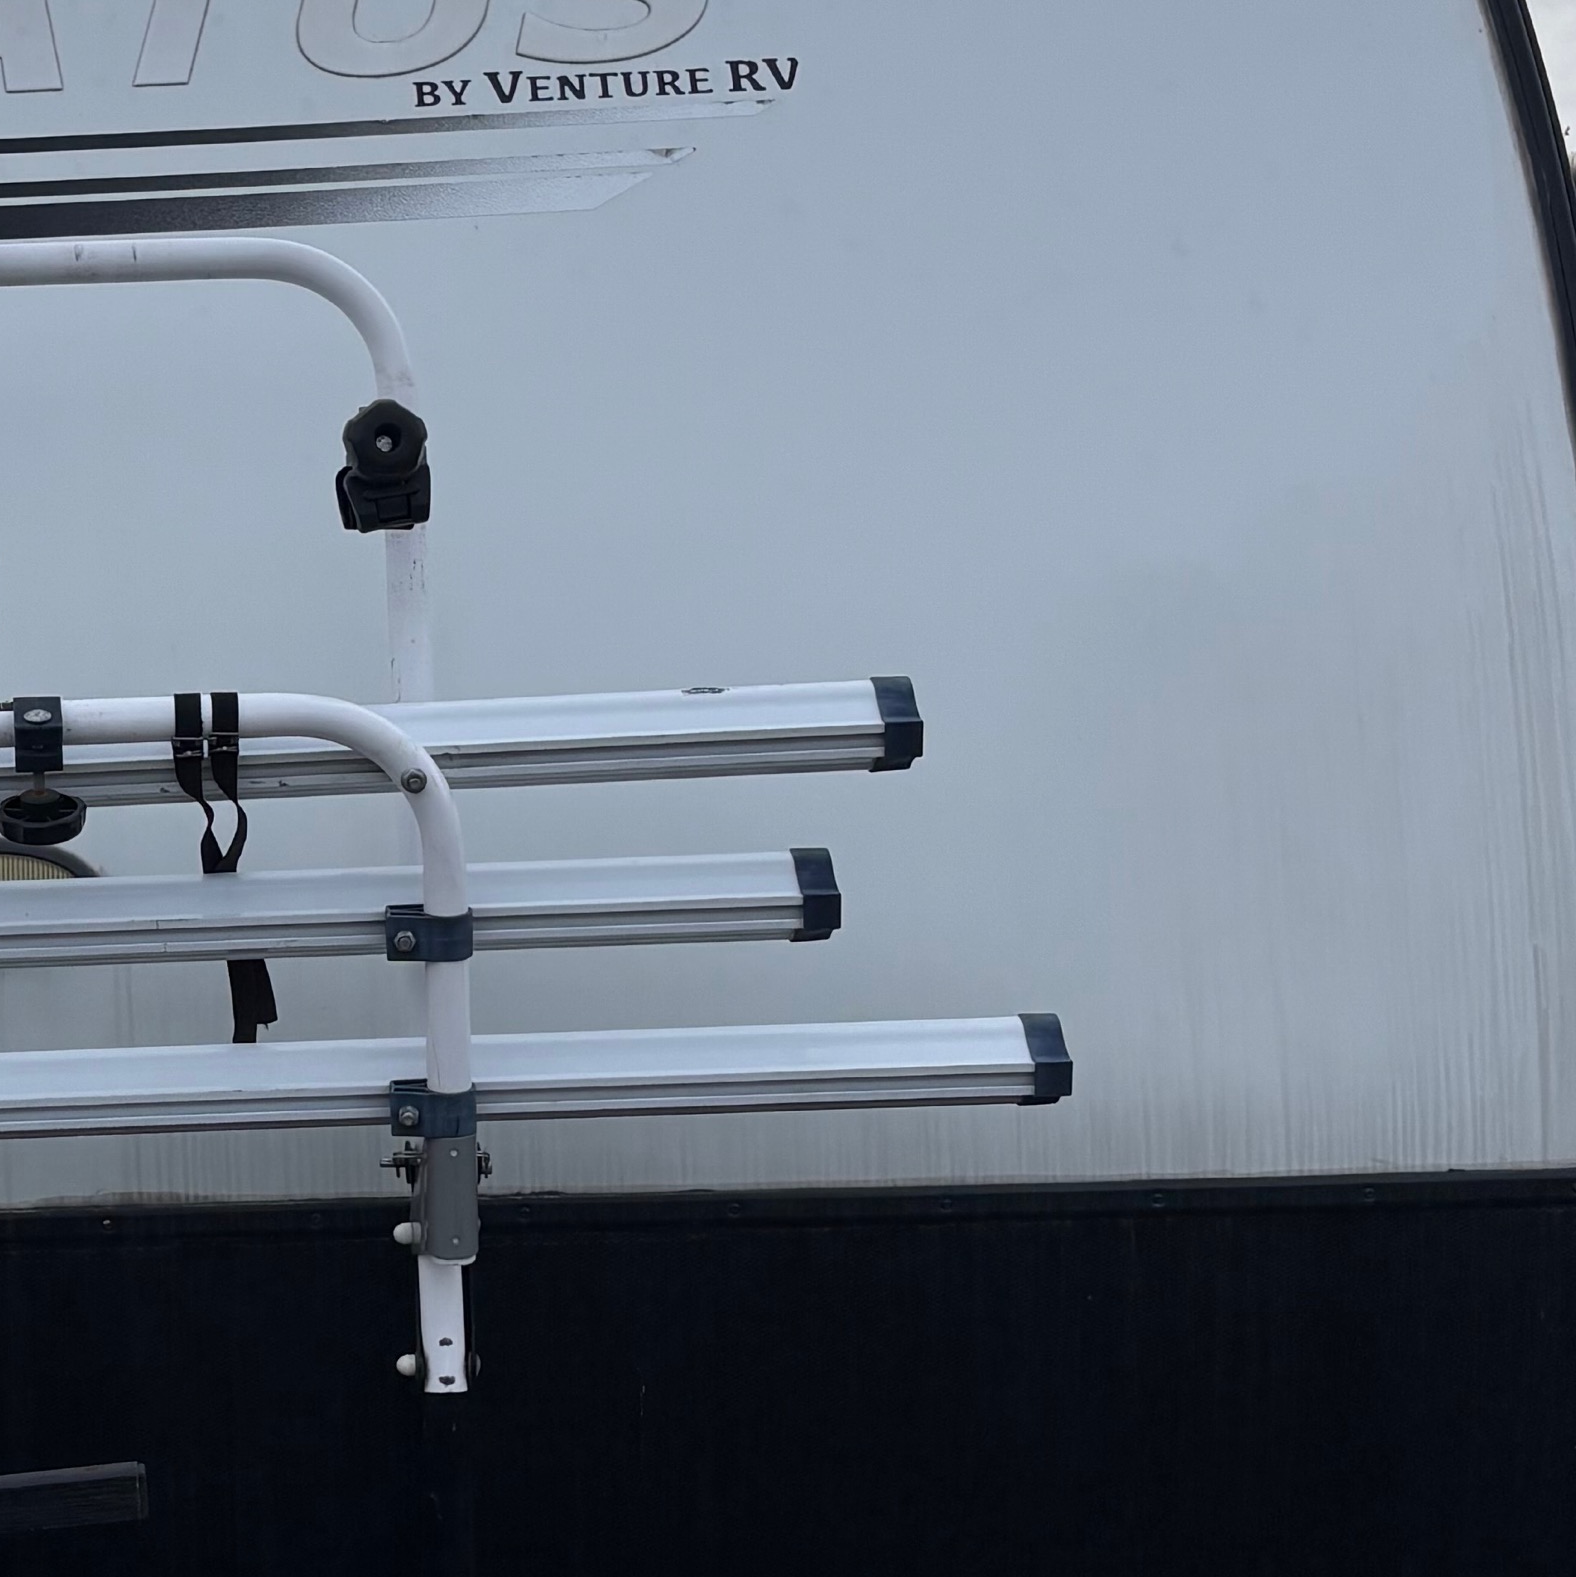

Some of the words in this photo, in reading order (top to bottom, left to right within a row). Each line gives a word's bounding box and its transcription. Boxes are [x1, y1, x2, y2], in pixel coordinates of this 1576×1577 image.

[412, 80, 471, 108] BY
[483, 68, 714, 104] VENTURE
[724, 57, 799, 93] RV
